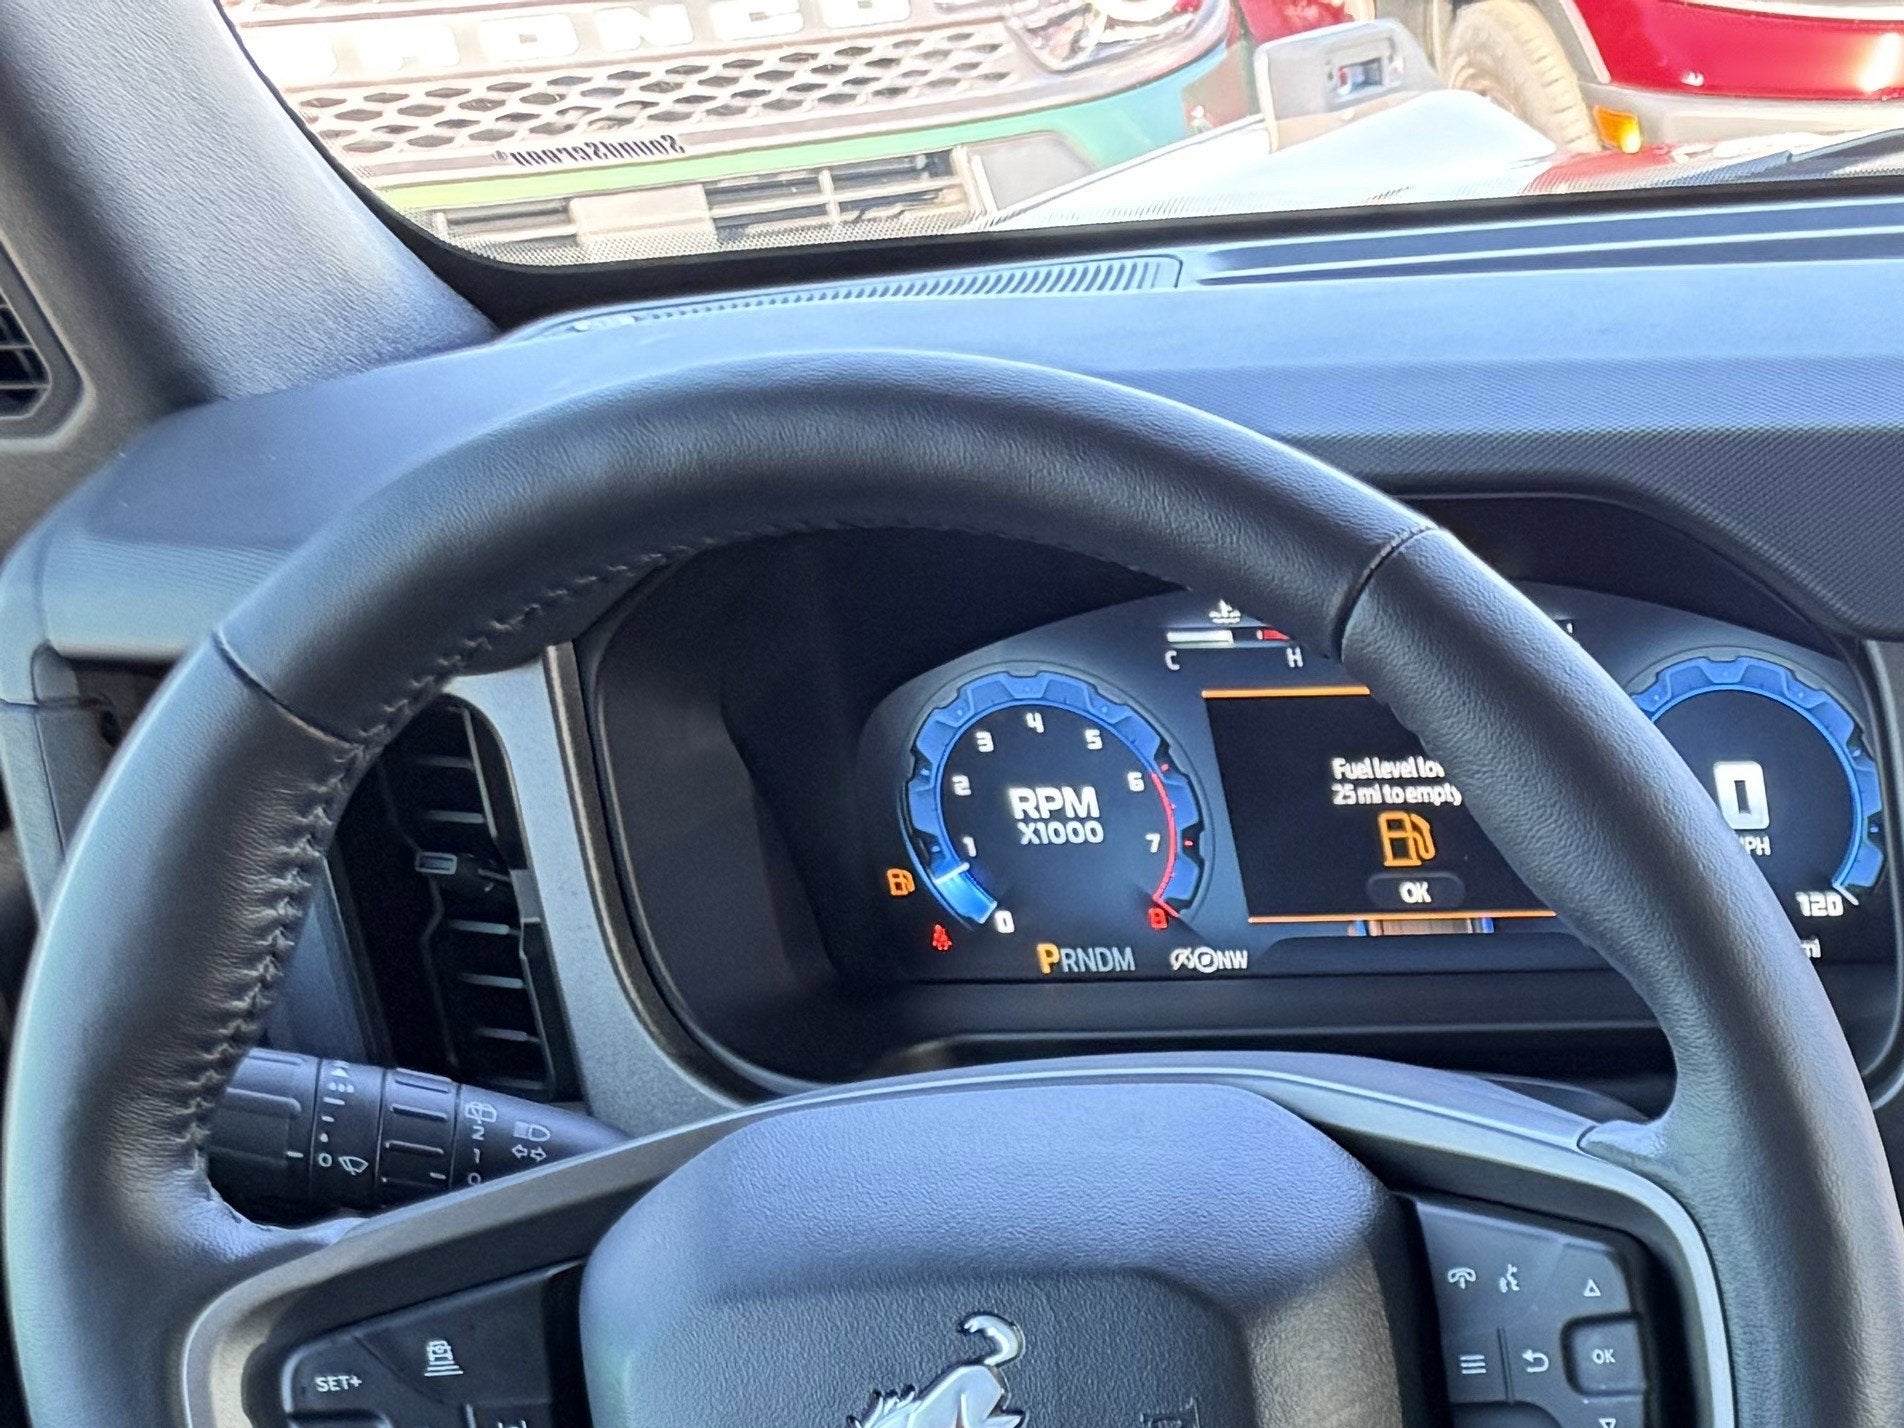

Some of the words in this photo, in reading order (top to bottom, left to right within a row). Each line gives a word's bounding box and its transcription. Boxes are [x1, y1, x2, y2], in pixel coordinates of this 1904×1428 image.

[1165, 651, 1180, 671] C
[1286, 646, 1303, 668] H
[1026, 713, 1044, 733] 4
[976, 731, 994, 752] 3
[1085, 729, 1102, 750] 5
[1331, 756, 1374, 780] Fuel
[1373, 756, 1418, 779] level
[952, 775, 972, 796] 2
[1127, 772, 1145, 792] 6
[1009, 787, 1100, 819] RPM
[1331, 783, 1357, 805] 25
[1358, 783, 1382, 804] mi
[1383, 784, 1405, 804] to
[1405, 783, 1463, 807] empty
[1713, 760, 1770, 830] 0
[1017, 821, 1104, 845] X1000
[1145, 833, 1161, 853] 7
[963, 837, 977, 857] 1
[1739, 836, 1771, 856] PH
[1400, 881, 1432, 904] OK
[1796, 891, 1844, 917] 120
[995, 910, 1015, 933] 0
[1592, 1348, 1615, 1365] OK
[316, 1375, 362, 1393] SET+
